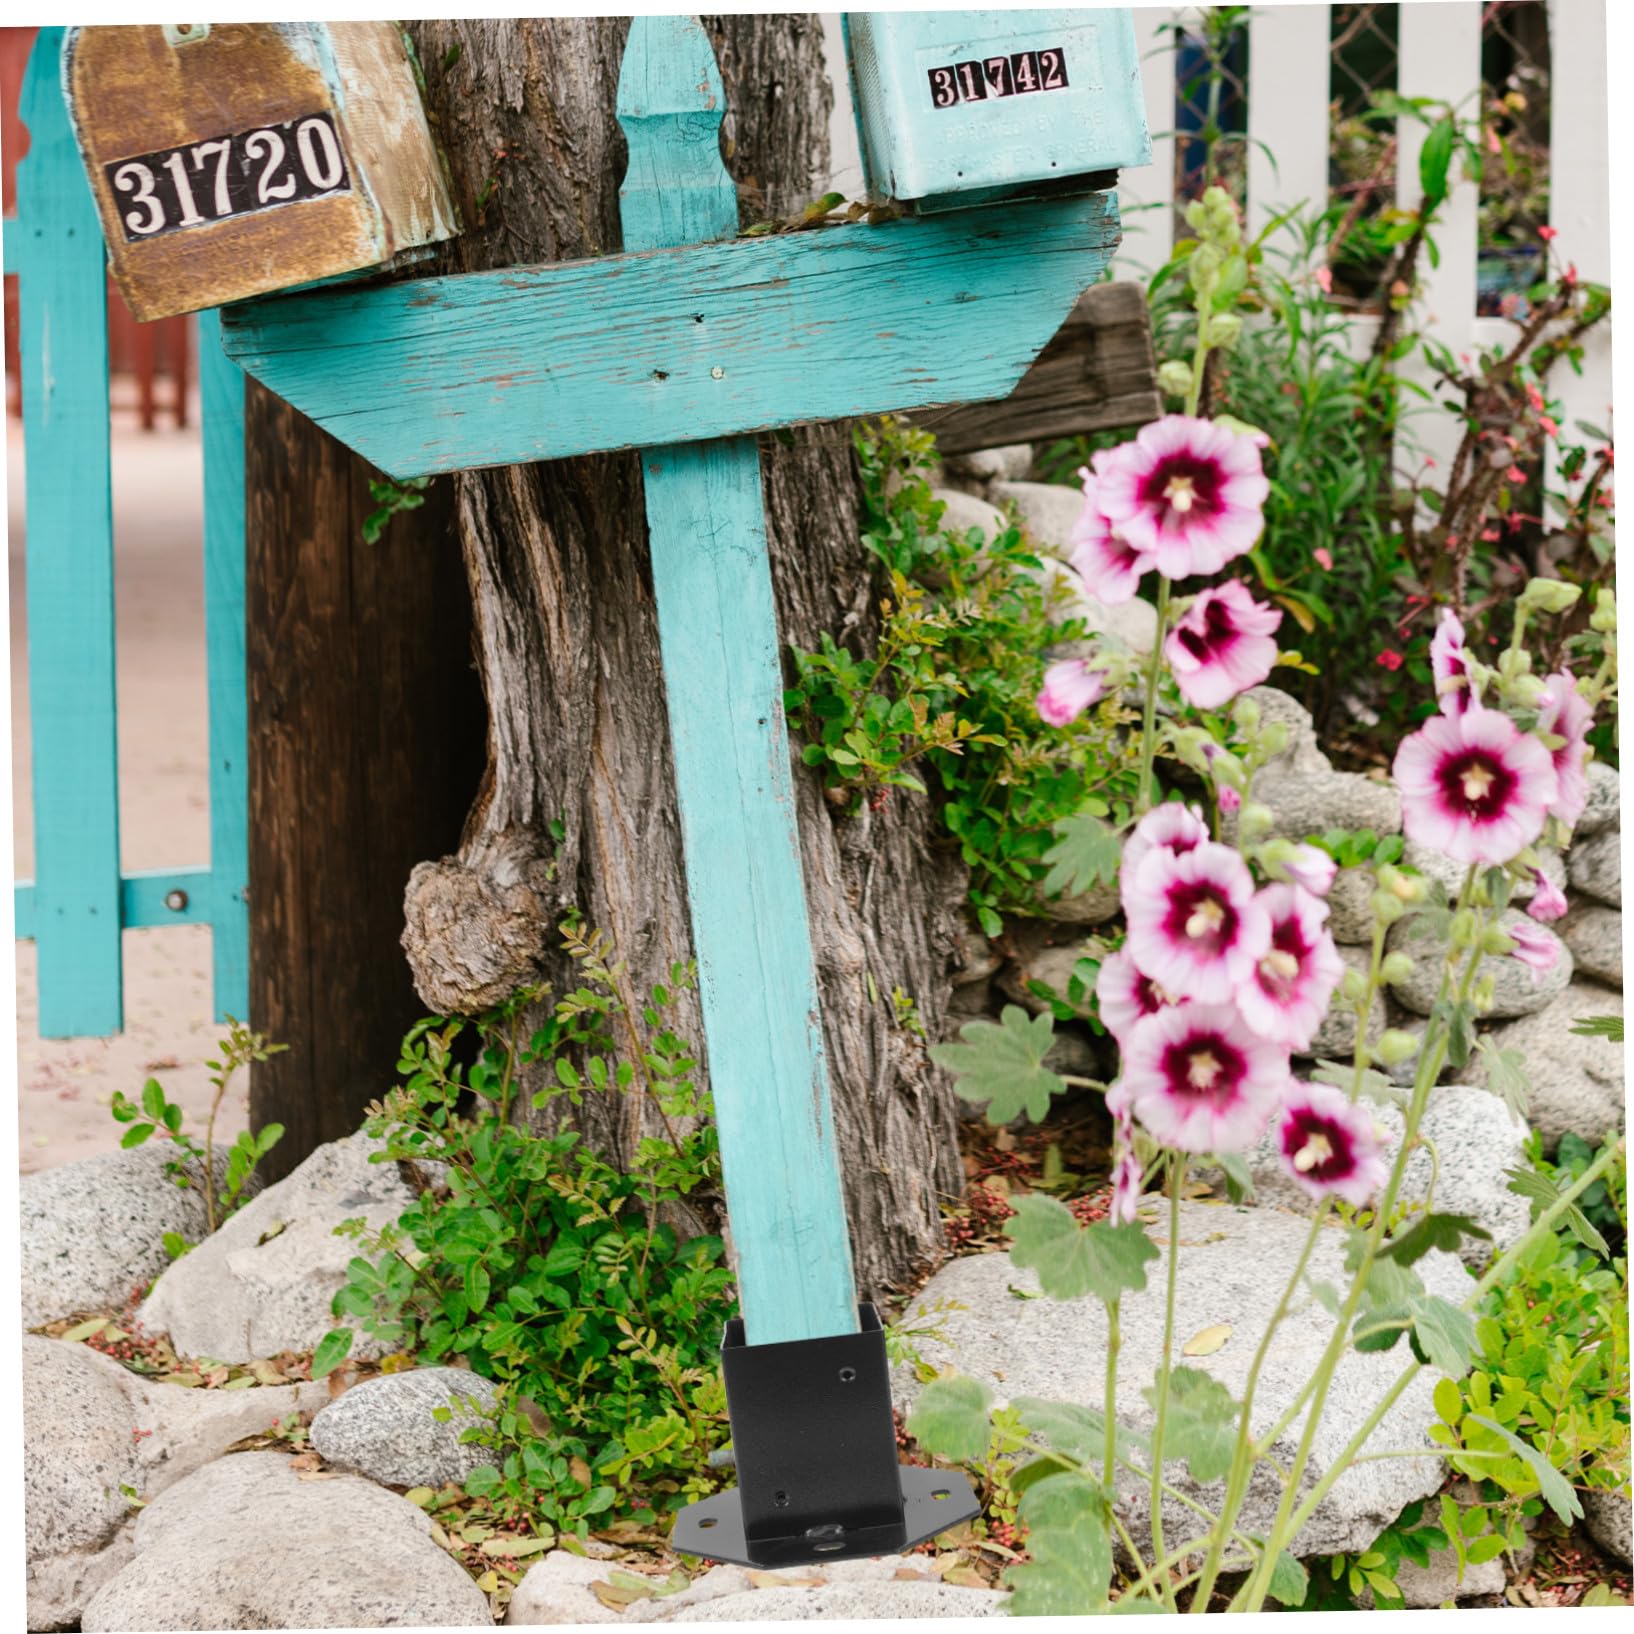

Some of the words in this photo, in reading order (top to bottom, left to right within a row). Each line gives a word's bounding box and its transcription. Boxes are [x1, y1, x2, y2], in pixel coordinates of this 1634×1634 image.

[934, 52, 1063, 106] 31742
[936, 119, 1023, 145] PPROVED
[114, 118, 343, 234] 31720
